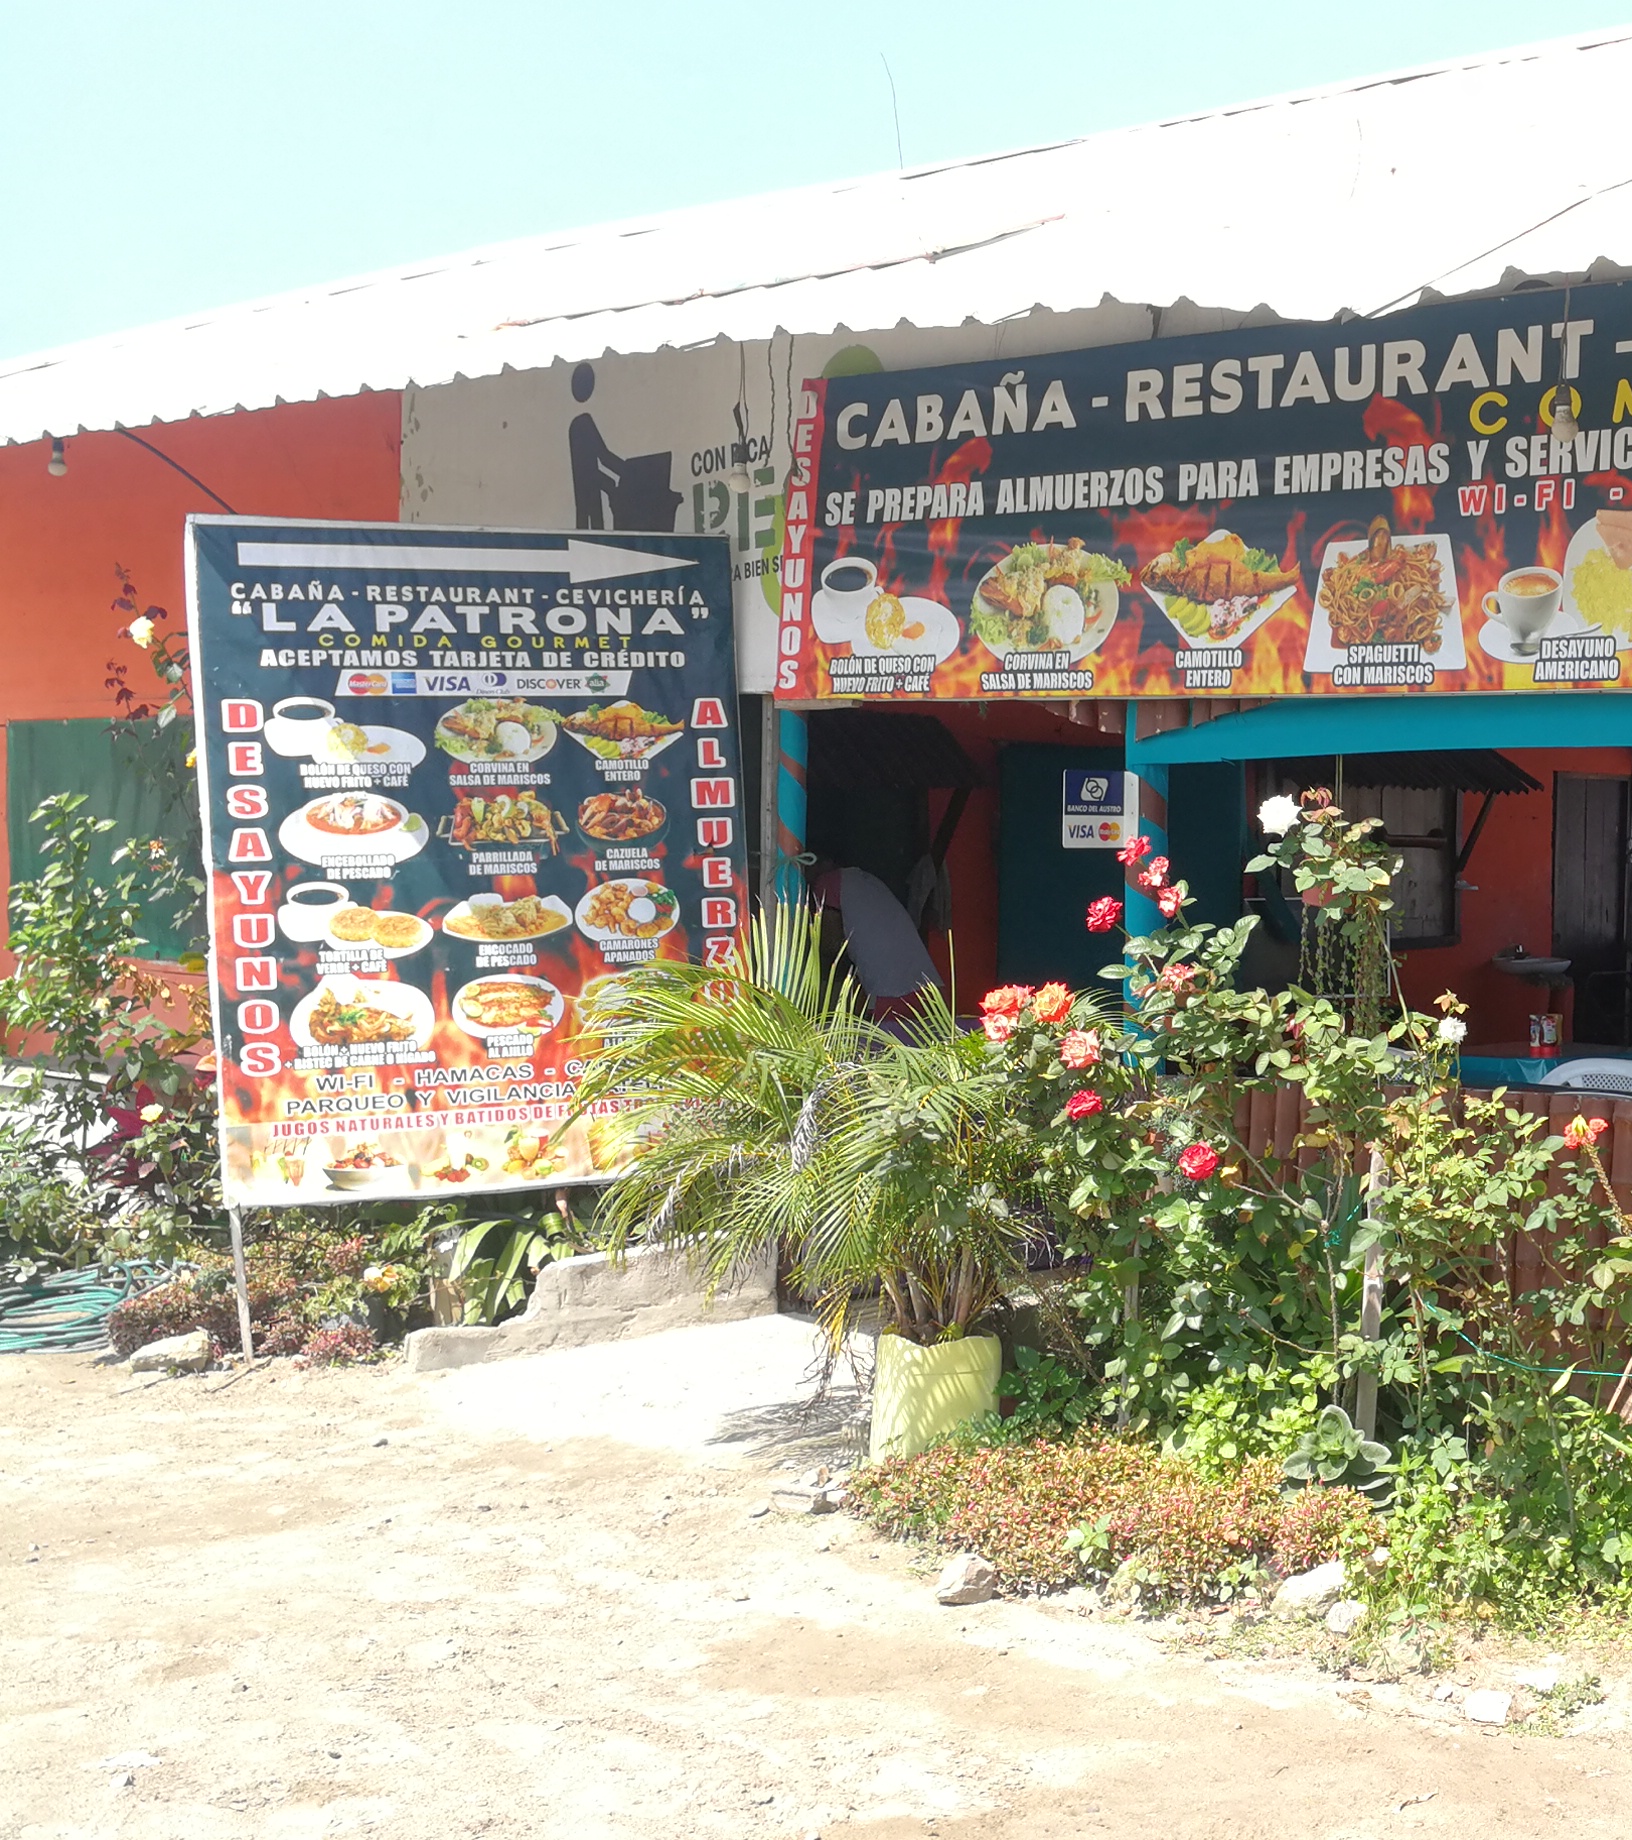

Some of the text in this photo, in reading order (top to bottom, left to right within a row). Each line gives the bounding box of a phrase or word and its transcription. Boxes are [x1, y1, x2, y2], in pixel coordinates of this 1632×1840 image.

[836, 370, 1077, 450] CABAÑA
[1125, 319, 1594, 423] RESTAURANT
[691, 445, 726, 477] CON
[824, 490, 857, 527] SE
[866, 481, 985, 524] PREPARA
[995, 465, 1164, 515] ALMUERZOS
[1178, 458, 1260, 502] PARA
[1273, 443, 1450, 495] EMPRESAS
[1467, 439, 1490, 481] Y
[1458, 477, 1577, 517] WI-FI
[778, 390, 819, 690] DESAYUNOS
[744, 557, 769, 579] BIEN
[230, 580, 705, 606] CABAÑA RESTAURANT CEVICHERÍA
[318, 633, 632, 649] COMIDA GOURMET
[1541, 638, 1616, 659] DESAYUNO
[260, 649, 686, 668] ACEPTAMOS TARJETA DE CRÉDITO
[1004, 652, 1070, 671] CORVINA EN
[1175, 650, 1242, 668] CAMOTILLO
[1349, 644, 1420, 664] SPAGUETTI
[829, 656, 935, 675] BOLÓN DE QUESO CON
[1333, 665, 1434, 685] CON MARISCOS
[1534, 660, 1619, 681] AMERICANO
[424, 676, 471, 692] VISA
[516, 678, 581, 690] DISCOVER
[833, 672, 930, 693] HUEVO FRITO CAFÉ
[981, 671, 1093, 690] SALSA DE MARISCOS
[1185, 669, 1231, 687] ENTERO
[469, 762, 529, 775] CORVINA EN
[595, 759, 649, 771] CAMOTILLO
[449, 773, 551, 786] SALSA DE MARISCOS
[604, 770, 641, 782] ENTERO
[1099, 805, 1122, 813] AUSTRO
[1068, 825, 1095, 838] VISA
[472, 851, 533, 863] PARRILLADA
[606, 848, 648, 860] CAZUELA
[469, 862, 538, 875] DE MARISCOS
[595, 858, 660, 872] DE MARISCOS
[220, 698, 282, 1078] DESAYUNOS
[479, 943, 533, 956] ENCOCADO
[599, 937, 659, 951] CAMARONES
[476, 954, 537, 968] DE PESCADO
[604, 950, 655, 963] APANADOS
[316, 1064, 532, 1091] WI-FI HAMACAS
[287, 1095, 404, 1115] PARQUEO
[416, 1091, 433, 1106] Y
[447, 1083, 576, 1104] VIGILANCIA
[273, 1121, 330, 1137] JUGOS
[336, 1114, 434, 1133] NATURALES
[440, 1113, 449, 1126] Y
[455, 1108, 528, 1125] BATIDOS
[533, 1106, 552, 1119] DE
